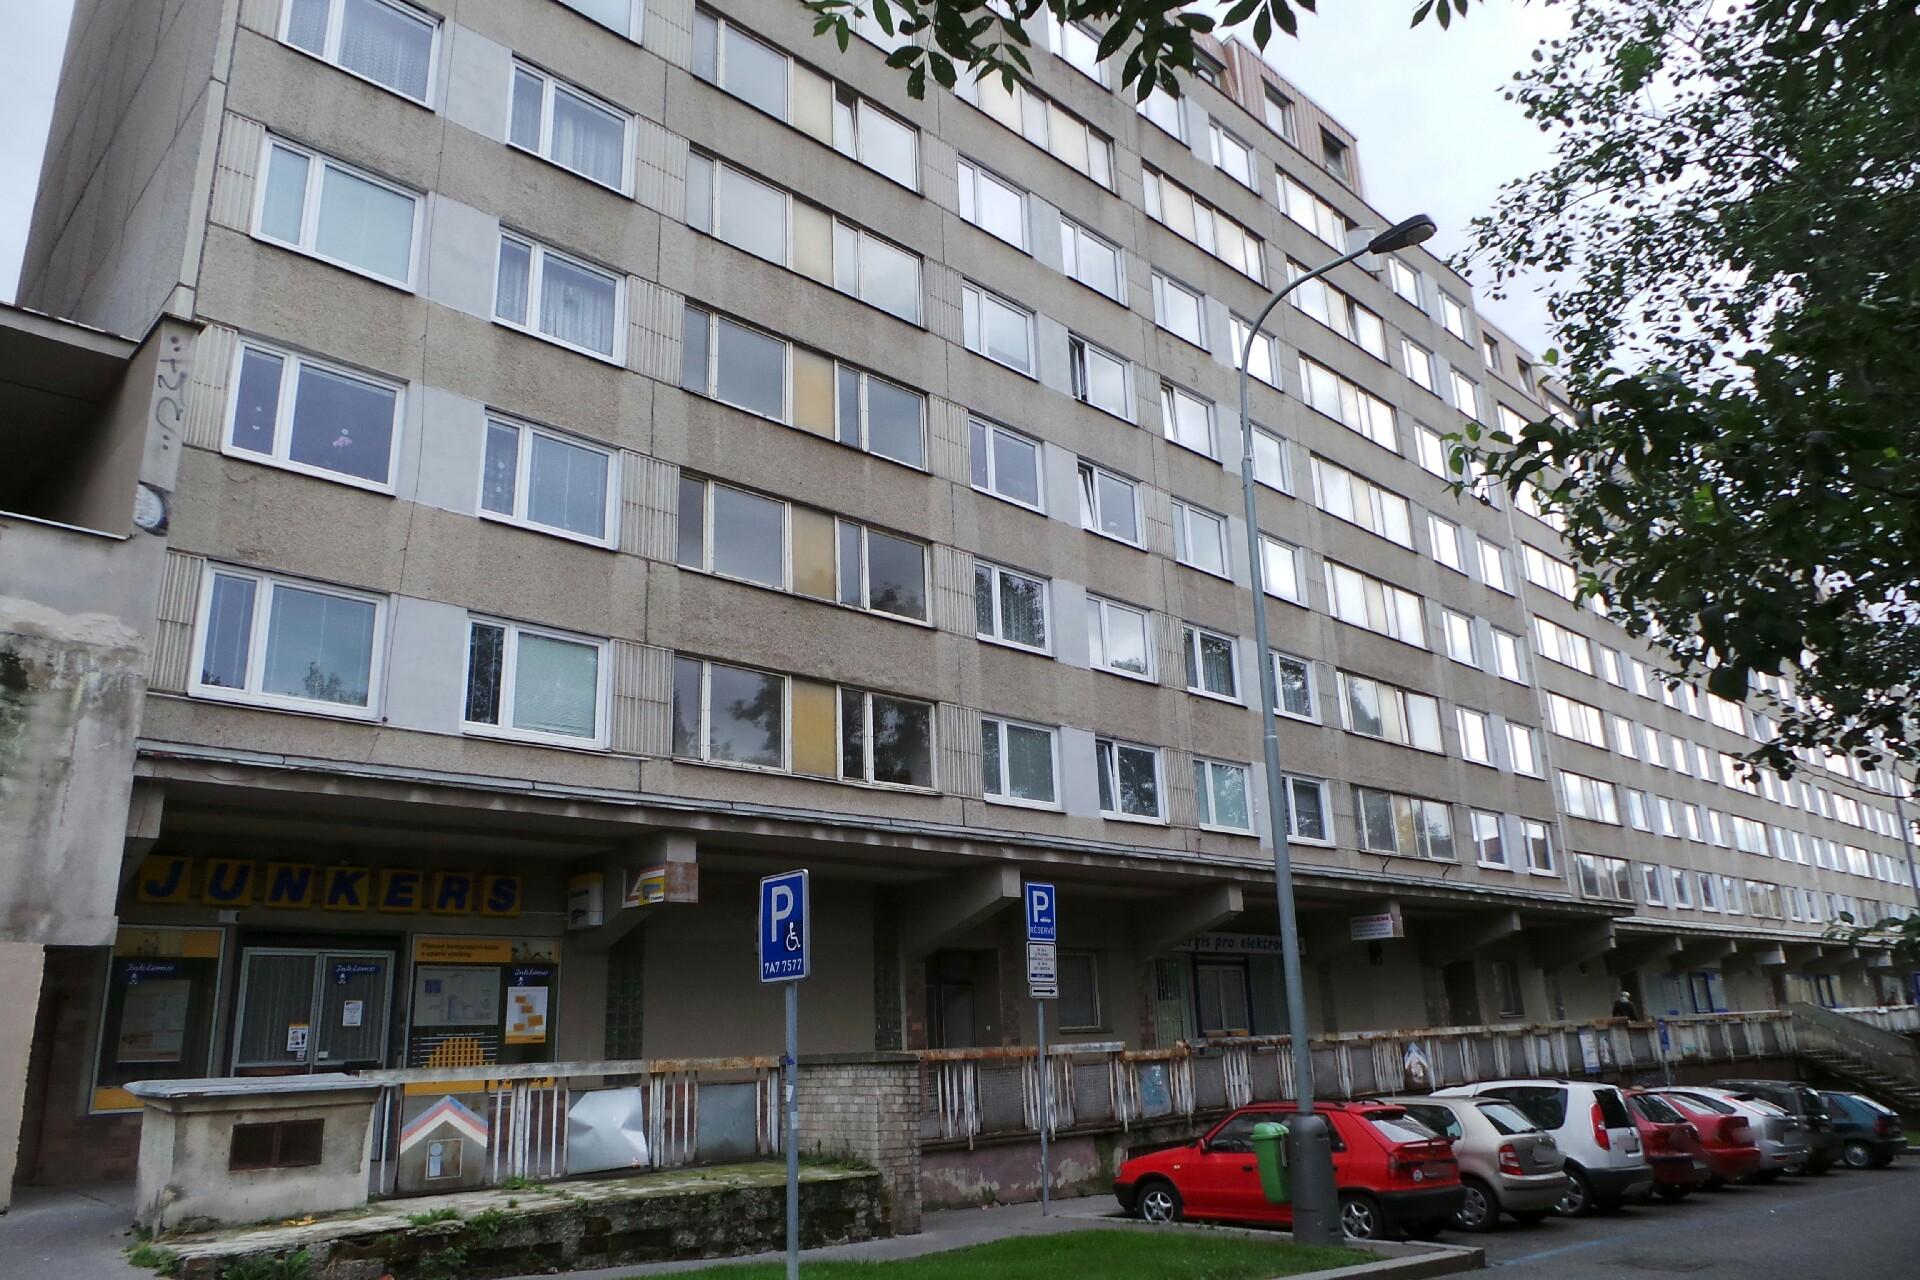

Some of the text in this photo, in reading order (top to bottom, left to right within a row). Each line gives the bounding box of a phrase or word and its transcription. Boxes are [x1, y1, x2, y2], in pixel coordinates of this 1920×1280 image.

[145, 860, 520, 913] JUNKERS
[771, 885, 794, 942] P
[1032, 890, 1049, 923] P
[1215, 936, 1234, 951] pro
[764, 958, 802, 975] 7A7 7577
